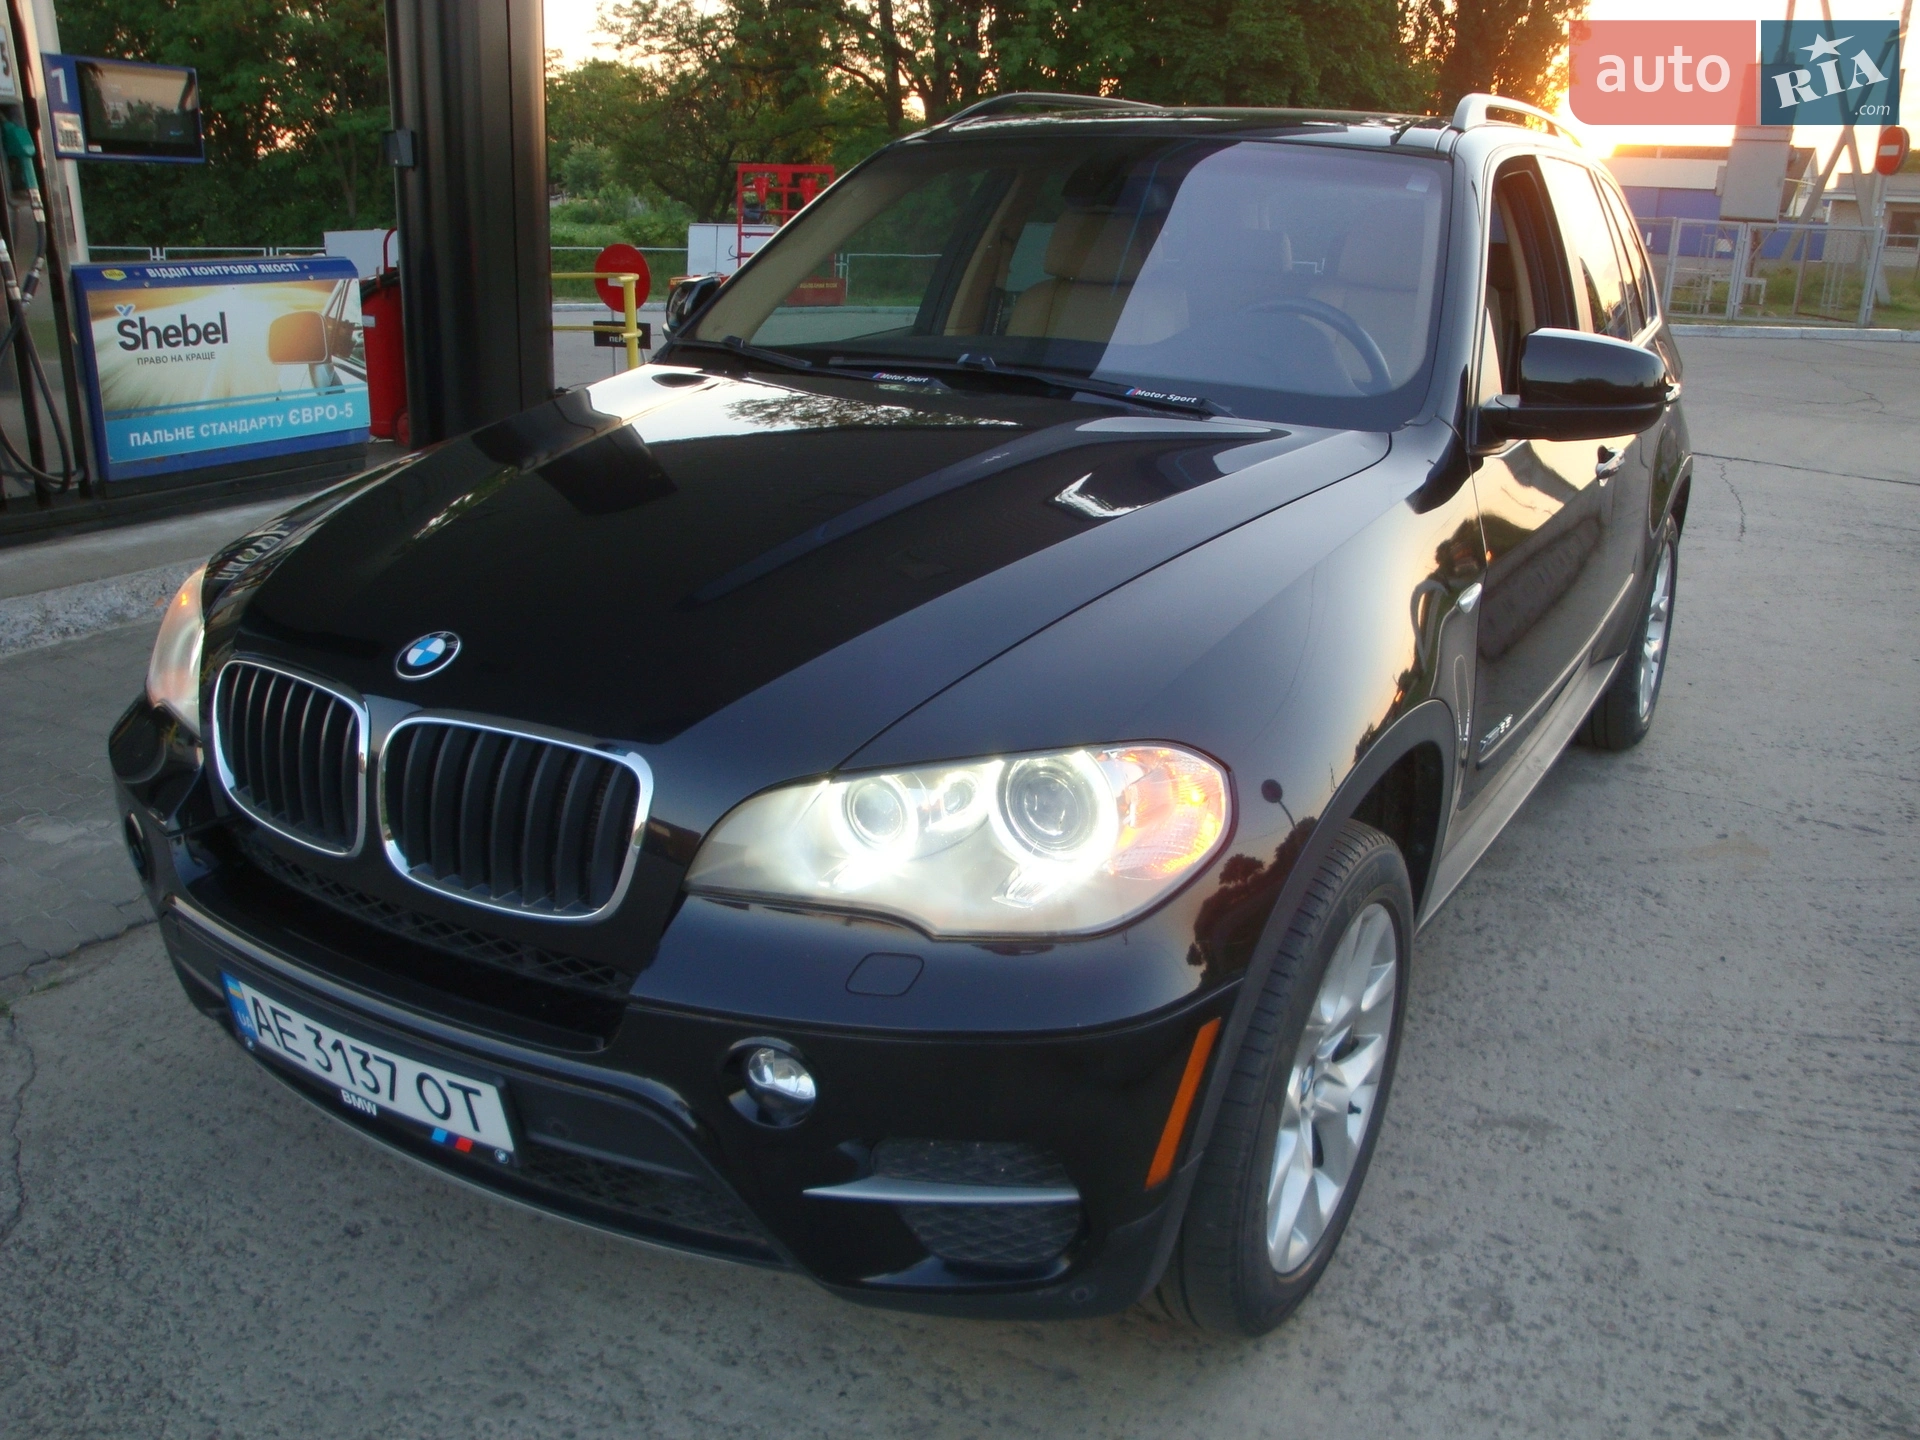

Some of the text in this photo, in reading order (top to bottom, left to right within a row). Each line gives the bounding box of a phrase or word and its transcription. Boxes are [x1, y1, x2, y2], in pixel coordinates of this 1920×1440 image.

[51, 67, 69, 104] 1
[145, 262, 301, 279] ВІДДІЛ КОНТРОЛЮ ЯКОСТІ
[136, 351, 216, 366] ПРАВО НА КРАЩЕ
[904, 375, 929, 383] Sport
[1135, 389, 1198, 403] Motor Sport
[129, 402, 354, 447] ПАЛЬНЕ СТАНДАРТУ ЄВРО-5
[340, 1089, 377, 1117] BMW
